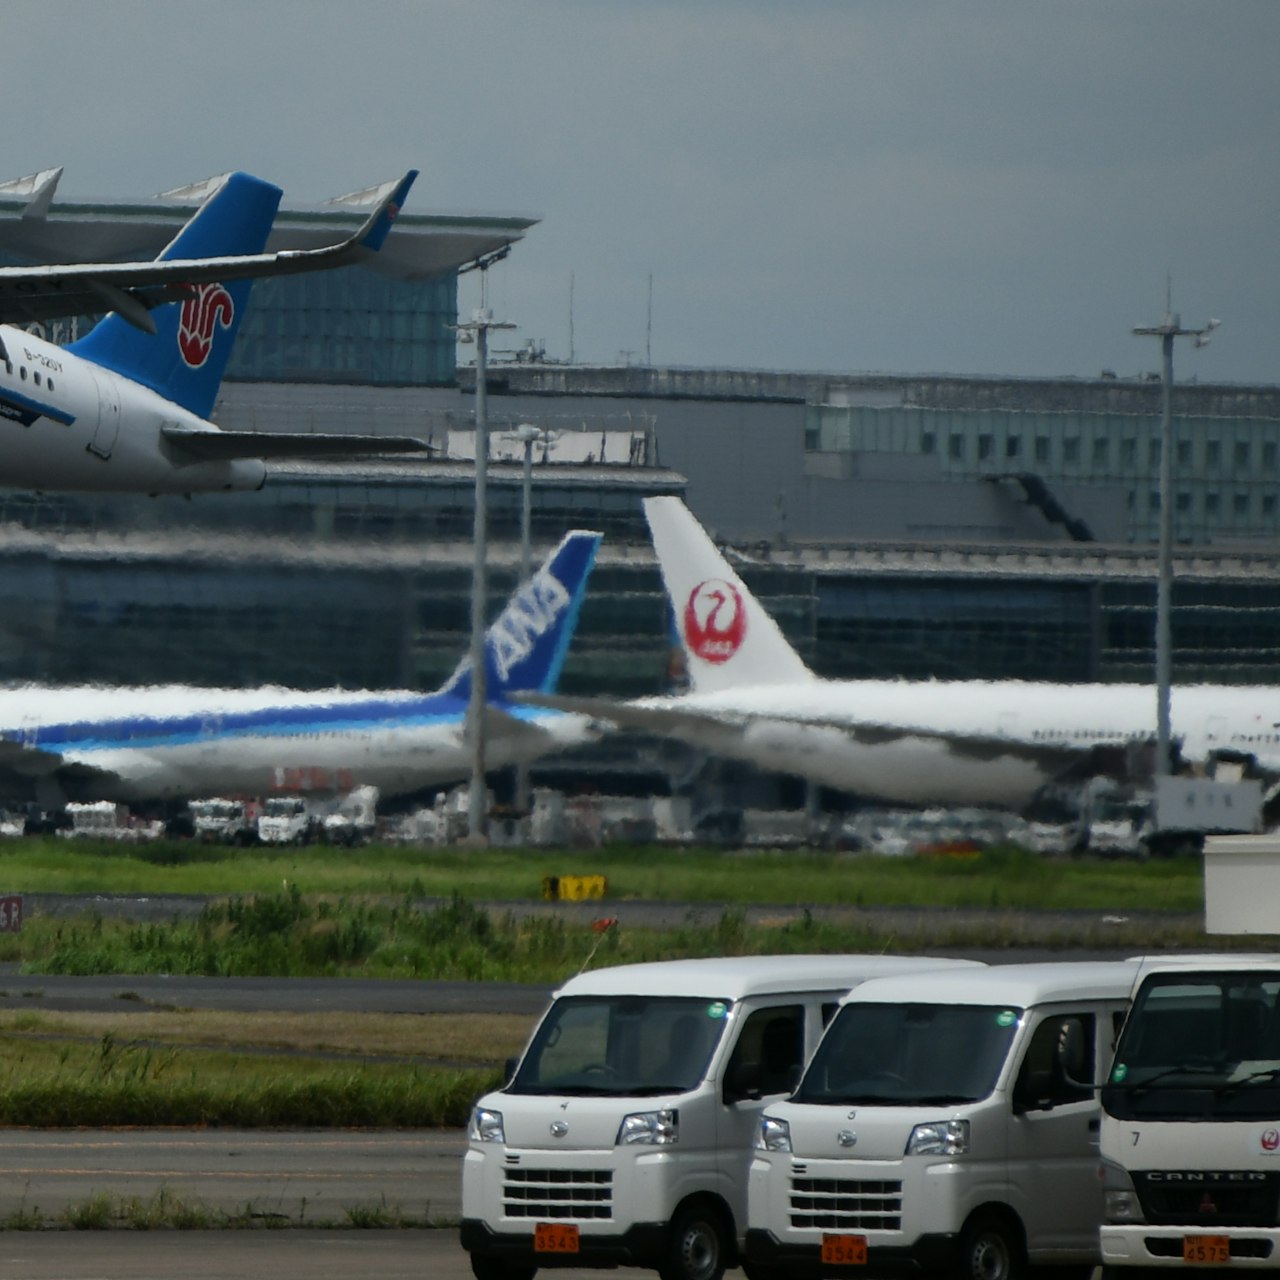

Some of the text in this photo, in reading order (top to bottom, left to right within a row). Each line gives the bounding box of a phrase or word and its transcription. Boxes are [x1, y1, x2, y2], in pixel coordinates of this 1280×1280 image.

[486, 572, 571, 682] ANA
[1132, 1132, 1141, 1147] 7
[1146, 1171, 1268, 1182] CANTER
[537, 1235, 577, 1251] 3543
[825, 1246, 865, 1262] 3544
[1187, 1245, 1228, 1263] 4575
